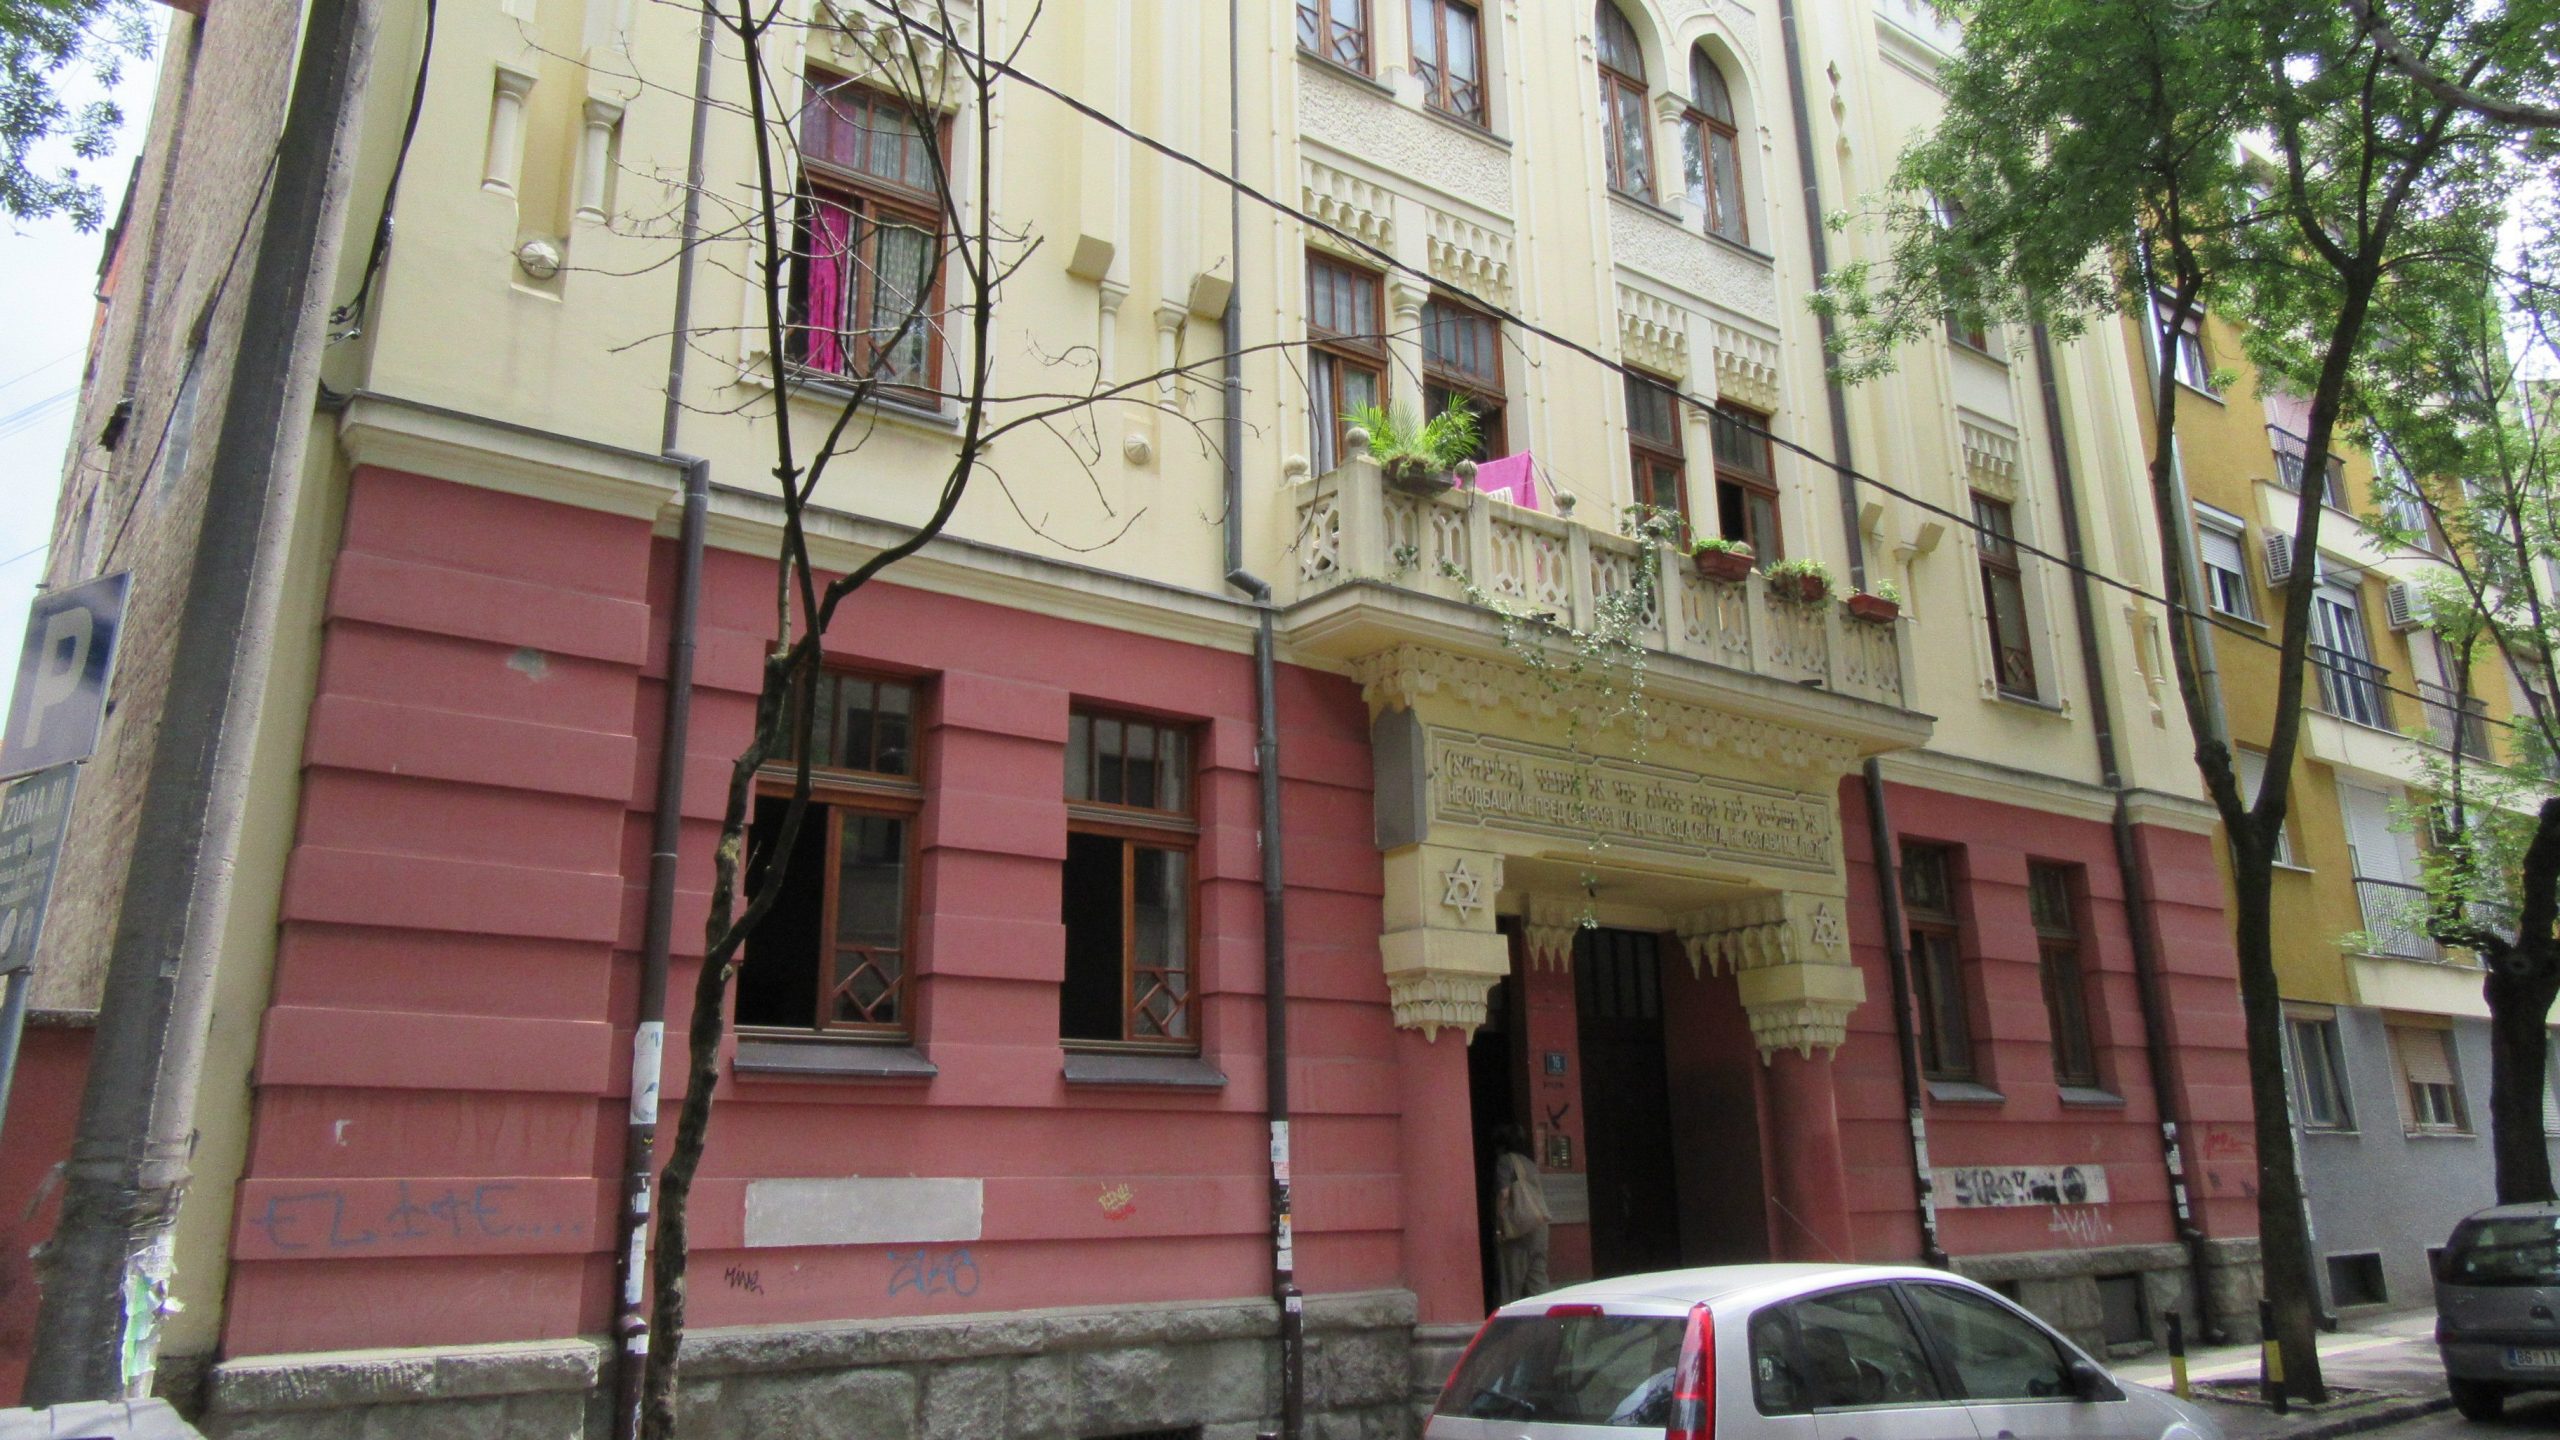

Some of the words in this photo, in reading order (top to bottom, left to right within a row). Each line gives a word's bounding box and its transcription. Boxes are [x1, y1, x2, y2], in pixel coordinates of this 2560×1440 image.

[22, 605, 93, 749] P
[2, 786, 46, 832] ZONA
[1448, 784, 1464, 804] НЕ
[1464, 785, 1513, 813] ОДБАЦИ
[1519, 793, 1537, 815] МЕ
[1537, 796, 1566, 820] ПРЕД
[1621, 809, 1644, 834] КАД
[1647, 814, 1663, 834] МЕ
